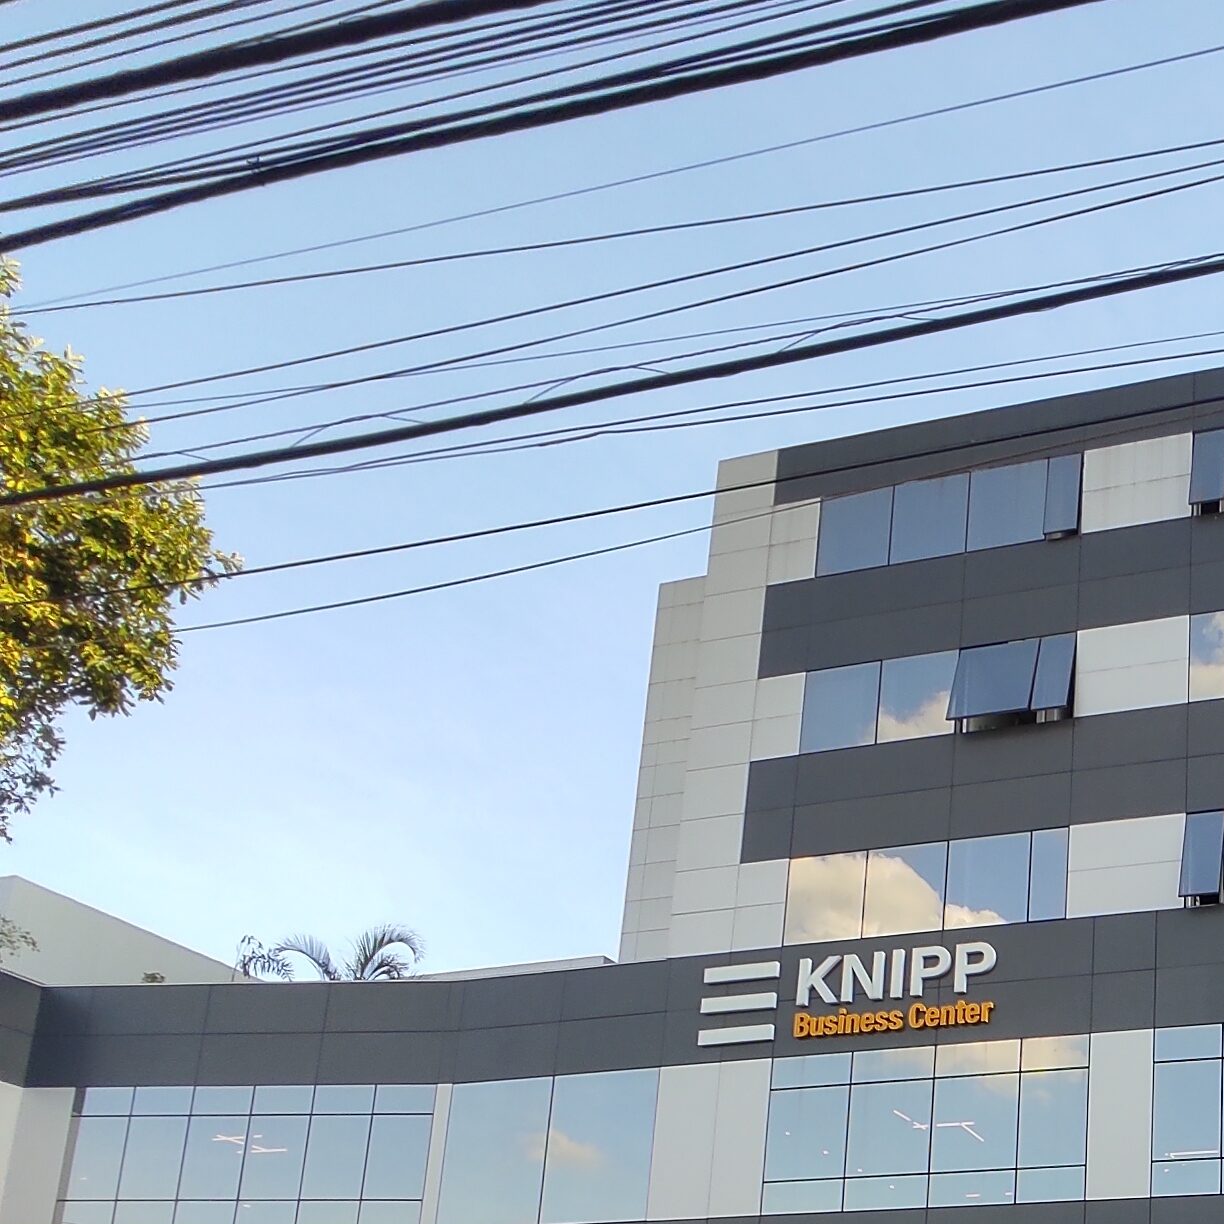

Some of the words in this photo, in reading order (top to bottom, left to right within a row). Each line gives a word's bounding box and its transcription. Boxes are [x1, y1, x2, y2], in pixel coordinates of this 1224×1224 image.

[795, 941, 997, 1007] KNIPP
[793, 1009, 903, 1038] Business
[909, 1000, 994, 1029] Center
